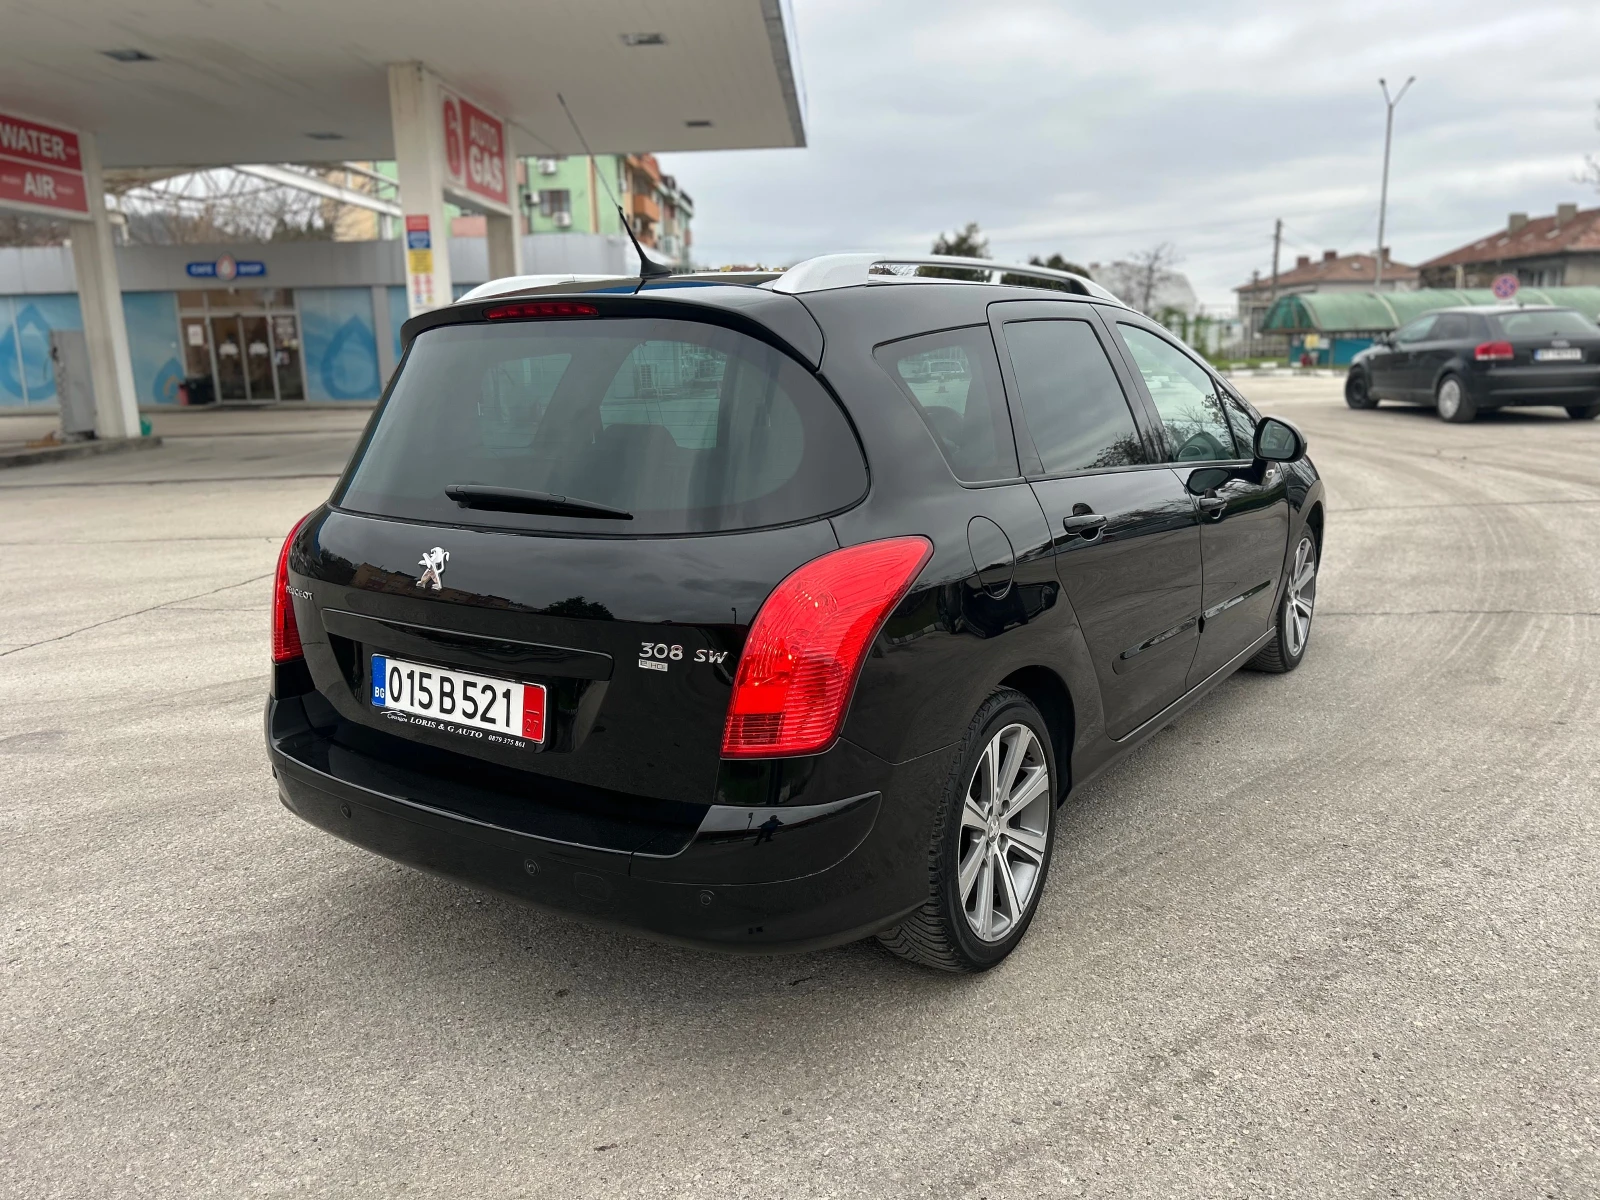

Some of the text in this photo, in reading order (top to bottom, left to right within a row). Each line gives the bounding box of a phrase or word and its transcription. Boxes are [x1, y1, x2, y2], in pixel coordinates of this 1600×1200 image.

[0, 122, 67, 161] WATER
[469, 115, 499, 153] AUTO
[469, 145, 503, 193] GAS
[24, 171, 57, 200] AIR
[286, 585, 313, 600] PEUGEOT
[639, 642, 729, 664] 308 SW
[374, 686, 385, 698] BG
[388, 666, 512, 728] 015B521
[409, 716, 437, 729] LORIS
[438, 723, 445, 731] &
[447, 725, 455, 733] G
[456, 728, 483, 739] AUTO
[525, 718, 539, 734] 27
[488, 734, 503, 743] 0879
[503, 737, 514, 746] 375
